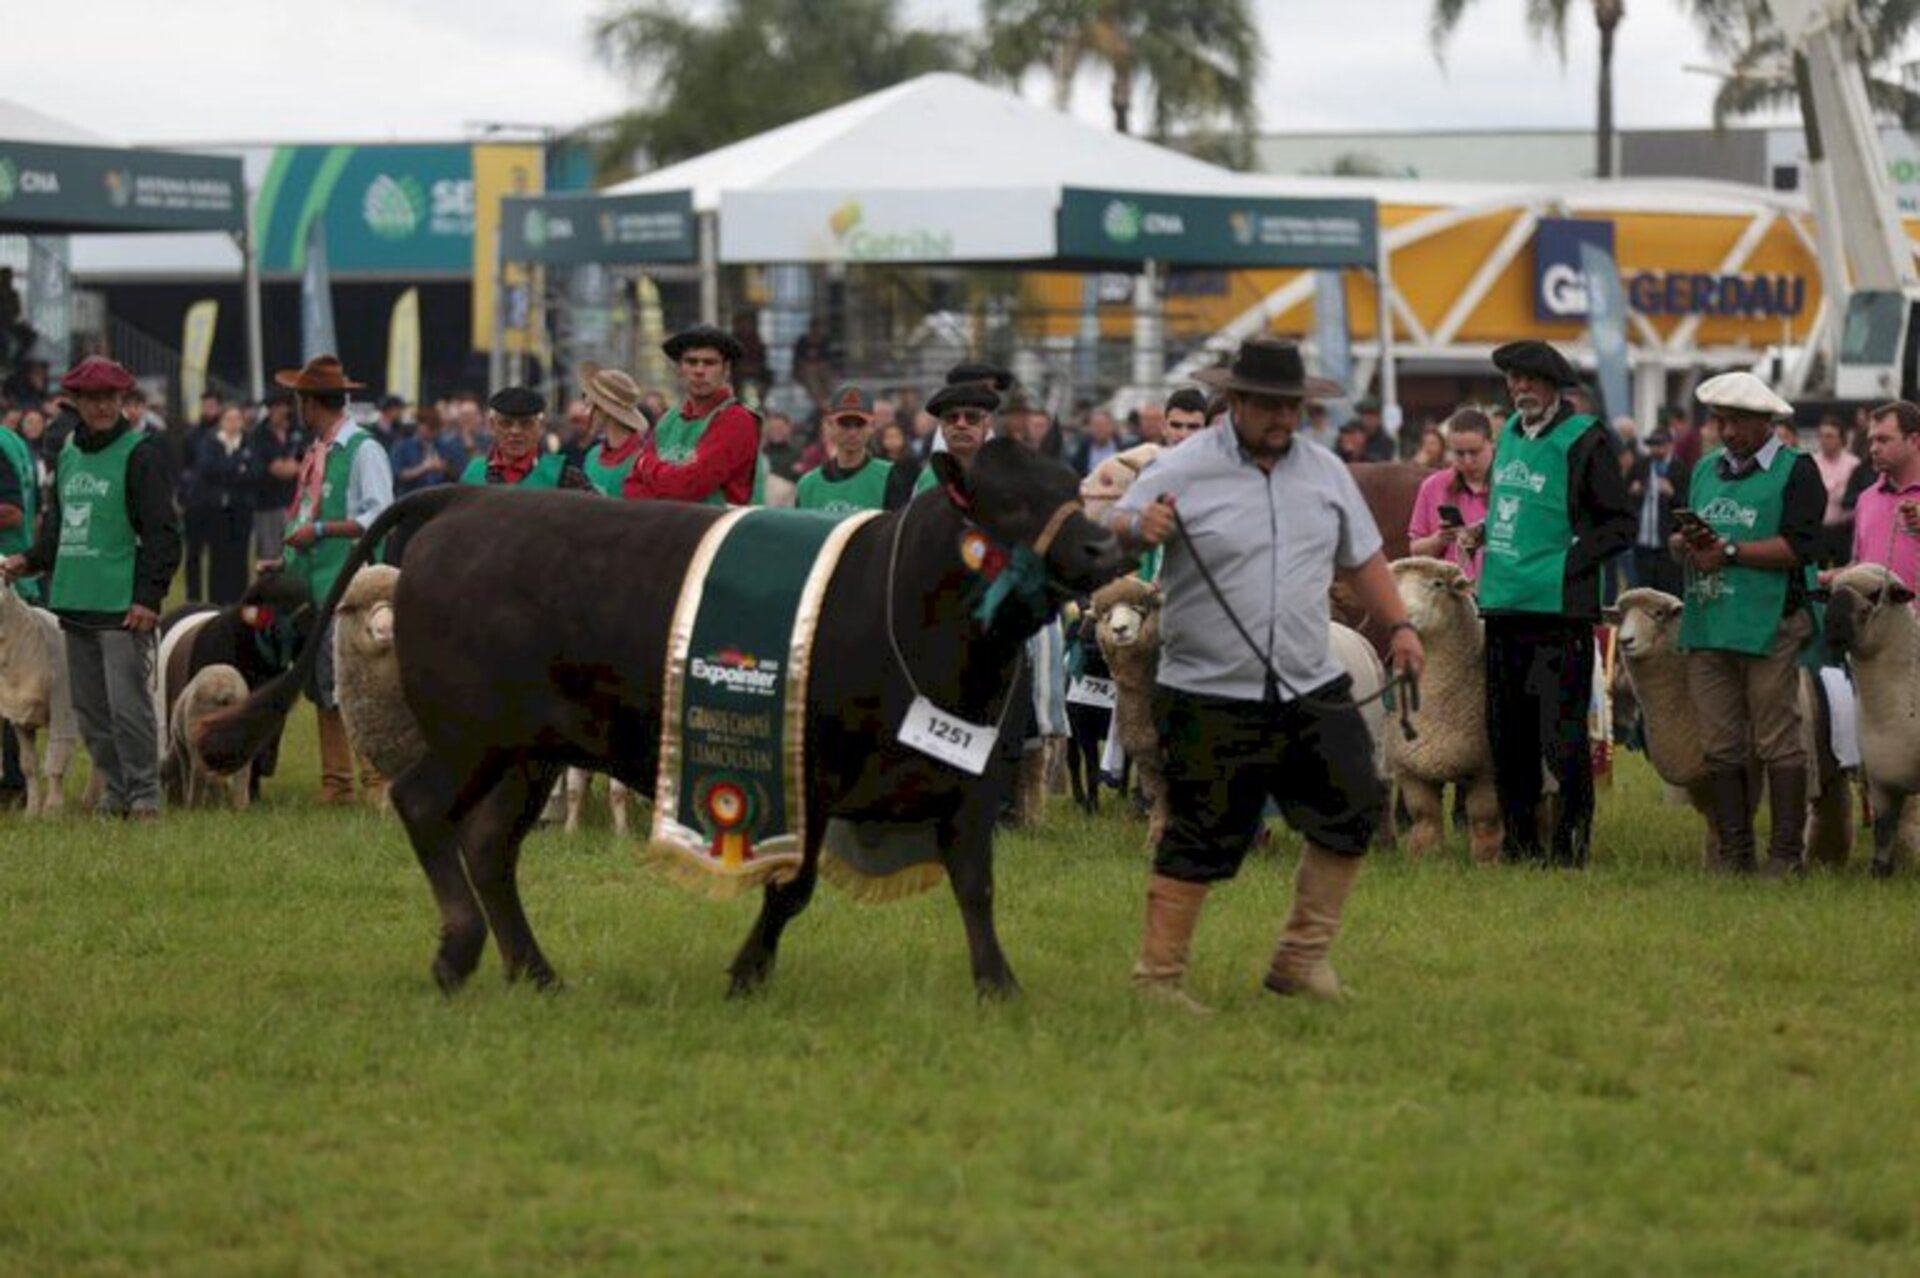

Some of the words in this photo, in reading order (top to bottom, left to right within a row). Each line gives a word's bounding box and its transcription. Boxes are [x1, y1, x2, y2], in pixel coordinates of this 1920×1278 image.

[20, 169, 60, 193] CNA
[1143, 212, 1185, 234] CNA
[1629, 272, 1805, 317] GERDAU
[691, 657, 777, 689] Expointer
[928, 716, 973, 750] 1251
